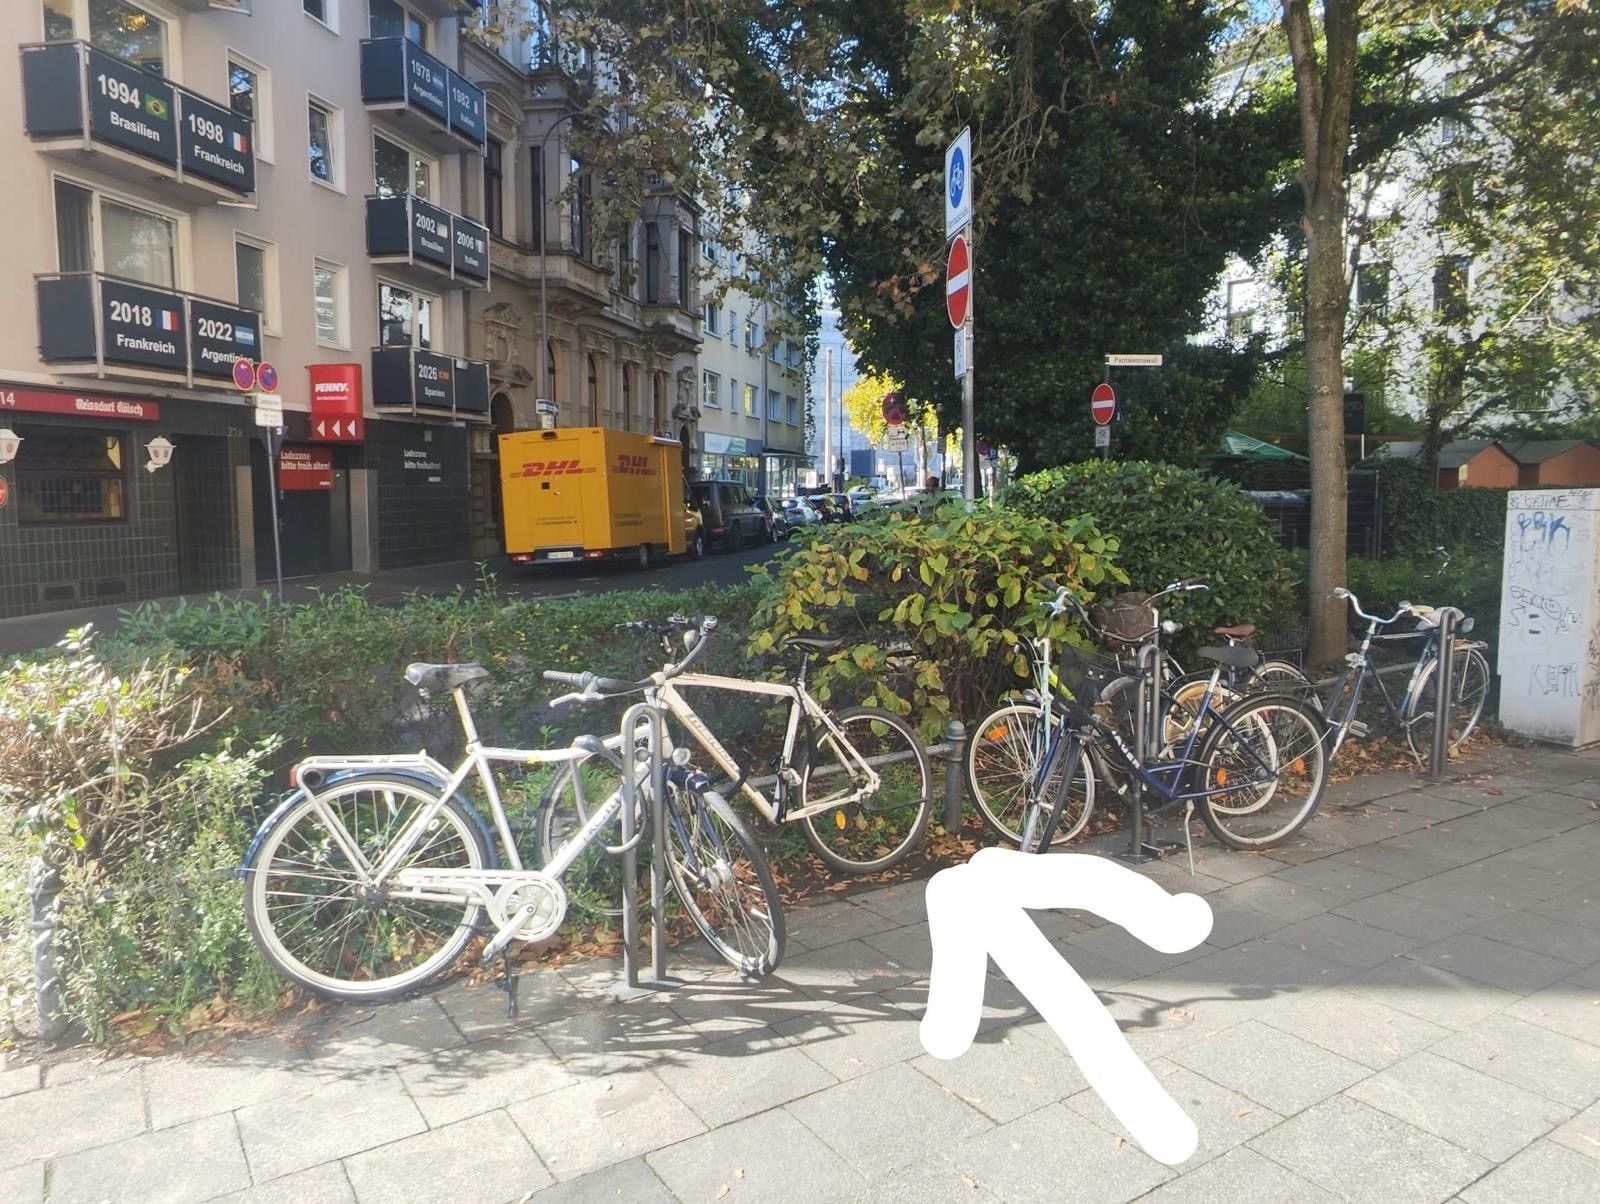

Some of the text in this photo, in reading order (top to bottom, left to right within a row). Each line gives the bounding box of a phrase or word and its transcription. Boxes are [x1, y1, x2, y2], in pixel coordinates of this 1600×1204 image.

[411, 59, 432, 83] 1978
[98, 74, 141, 109] 1994
[110, 111, 160, 142] Brasilien
[188, 113, 224, 144] 1998
[194, 144, 245, 175] Frankreich
[416, 213, 436, 234] 2002
[457, 231, 475, 250] 2006
[110, 300, 152, 327] 2018
[198, 317, 233, 342] 2022
[116, 333, 175, 355] Frankreich
[418, 364, 438, 380] 2026
[521, 459, 585, 478] DHL
